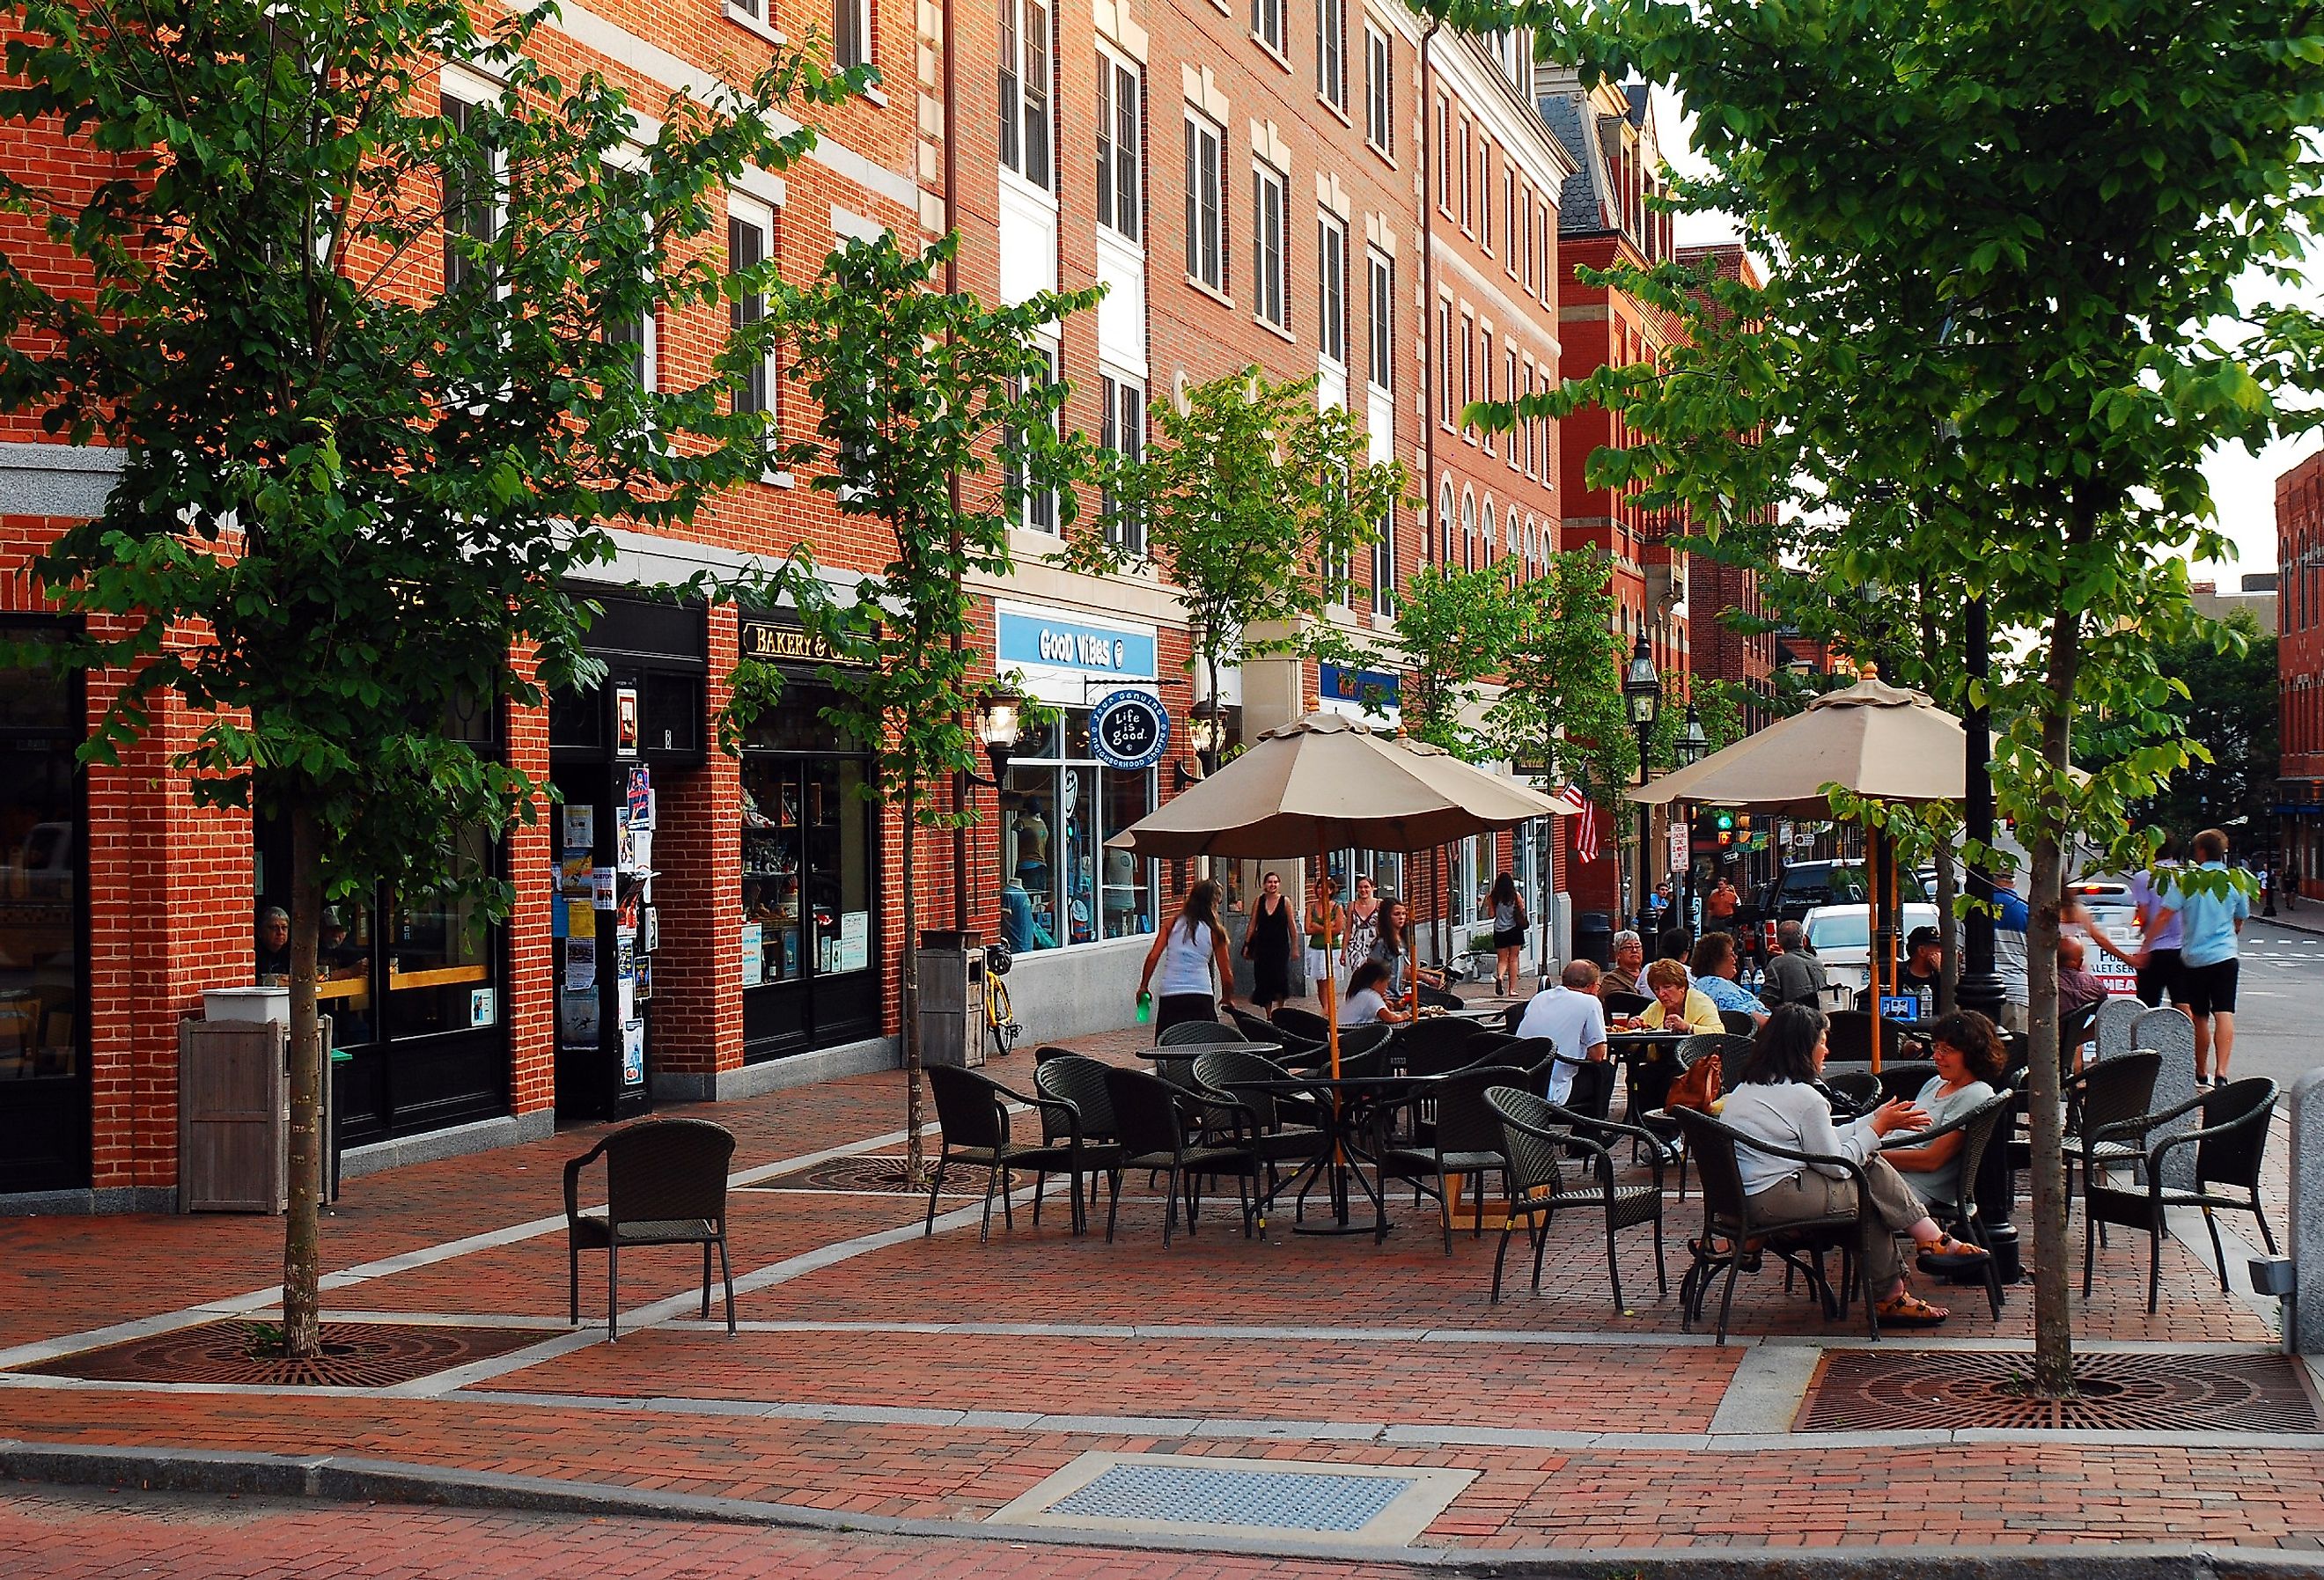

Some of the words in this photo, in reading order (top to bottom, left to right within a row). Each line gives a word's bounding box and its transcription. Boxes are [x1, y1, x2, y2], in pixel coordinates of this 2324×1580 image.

[755, 627, 812, 656] BAKERY
[814, 636, 827, 657] &
[1115, 709, 1140, 724] Life
[1123, 724, 1136, 732] is
[1113, 728, 1148, 746] good.
